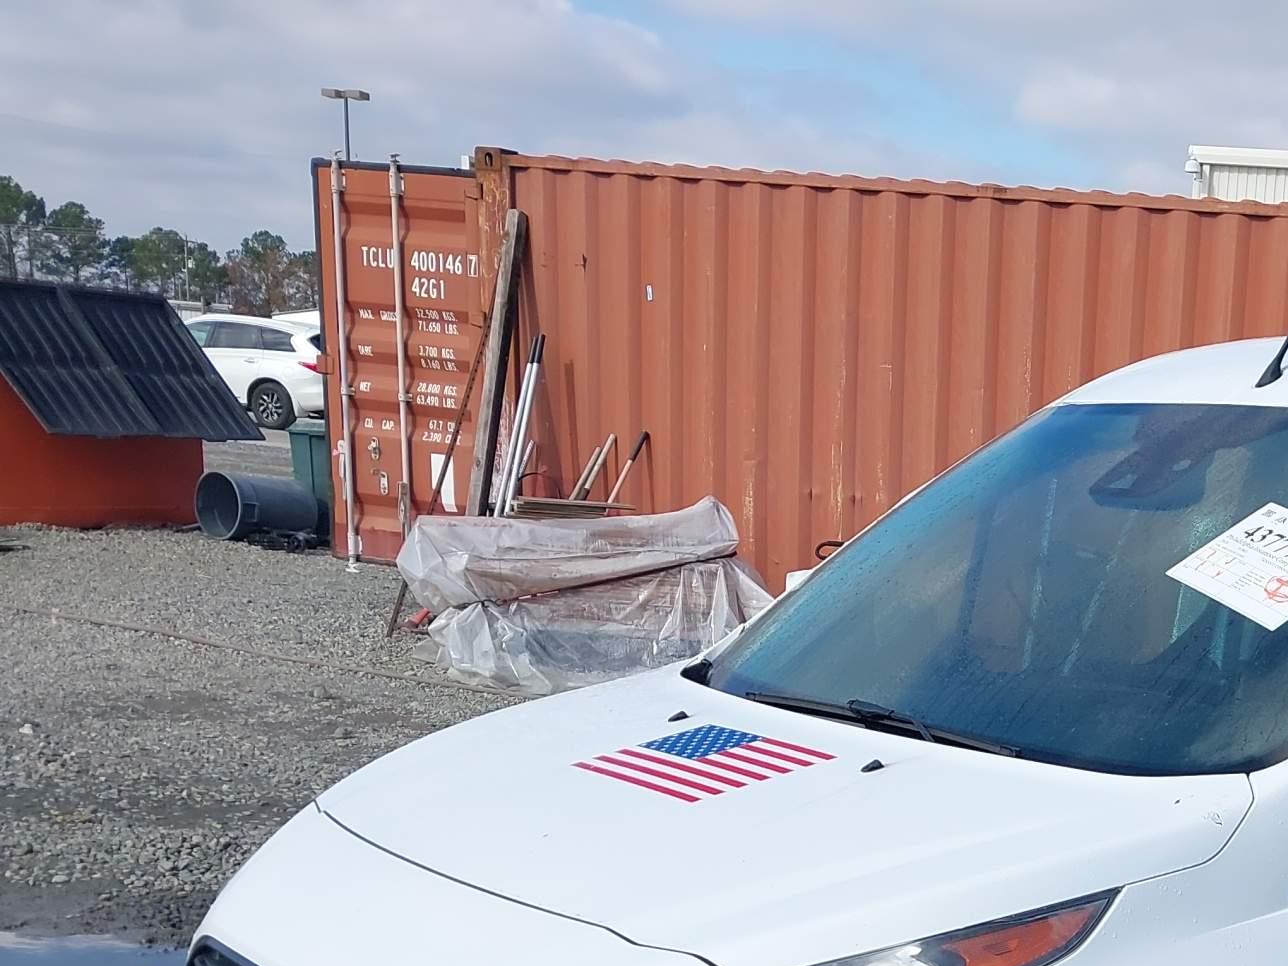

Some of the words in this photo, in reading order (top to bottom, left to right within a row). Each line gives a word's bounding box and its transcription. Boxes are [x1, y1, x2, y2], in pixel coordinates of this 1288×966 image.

[361, 246, 395, 269] TCLU
[410, 250, 463, 275] 400146
[467, 254, 479, 277] 7
[411, 276, 445, 300] 42G1
[417, 320, 441, 333] 71.650
[444, 323, 459, 336] LBS.
[418, 345, 438, 358] 3.700
[416, 394, 439, 407] 63.490
